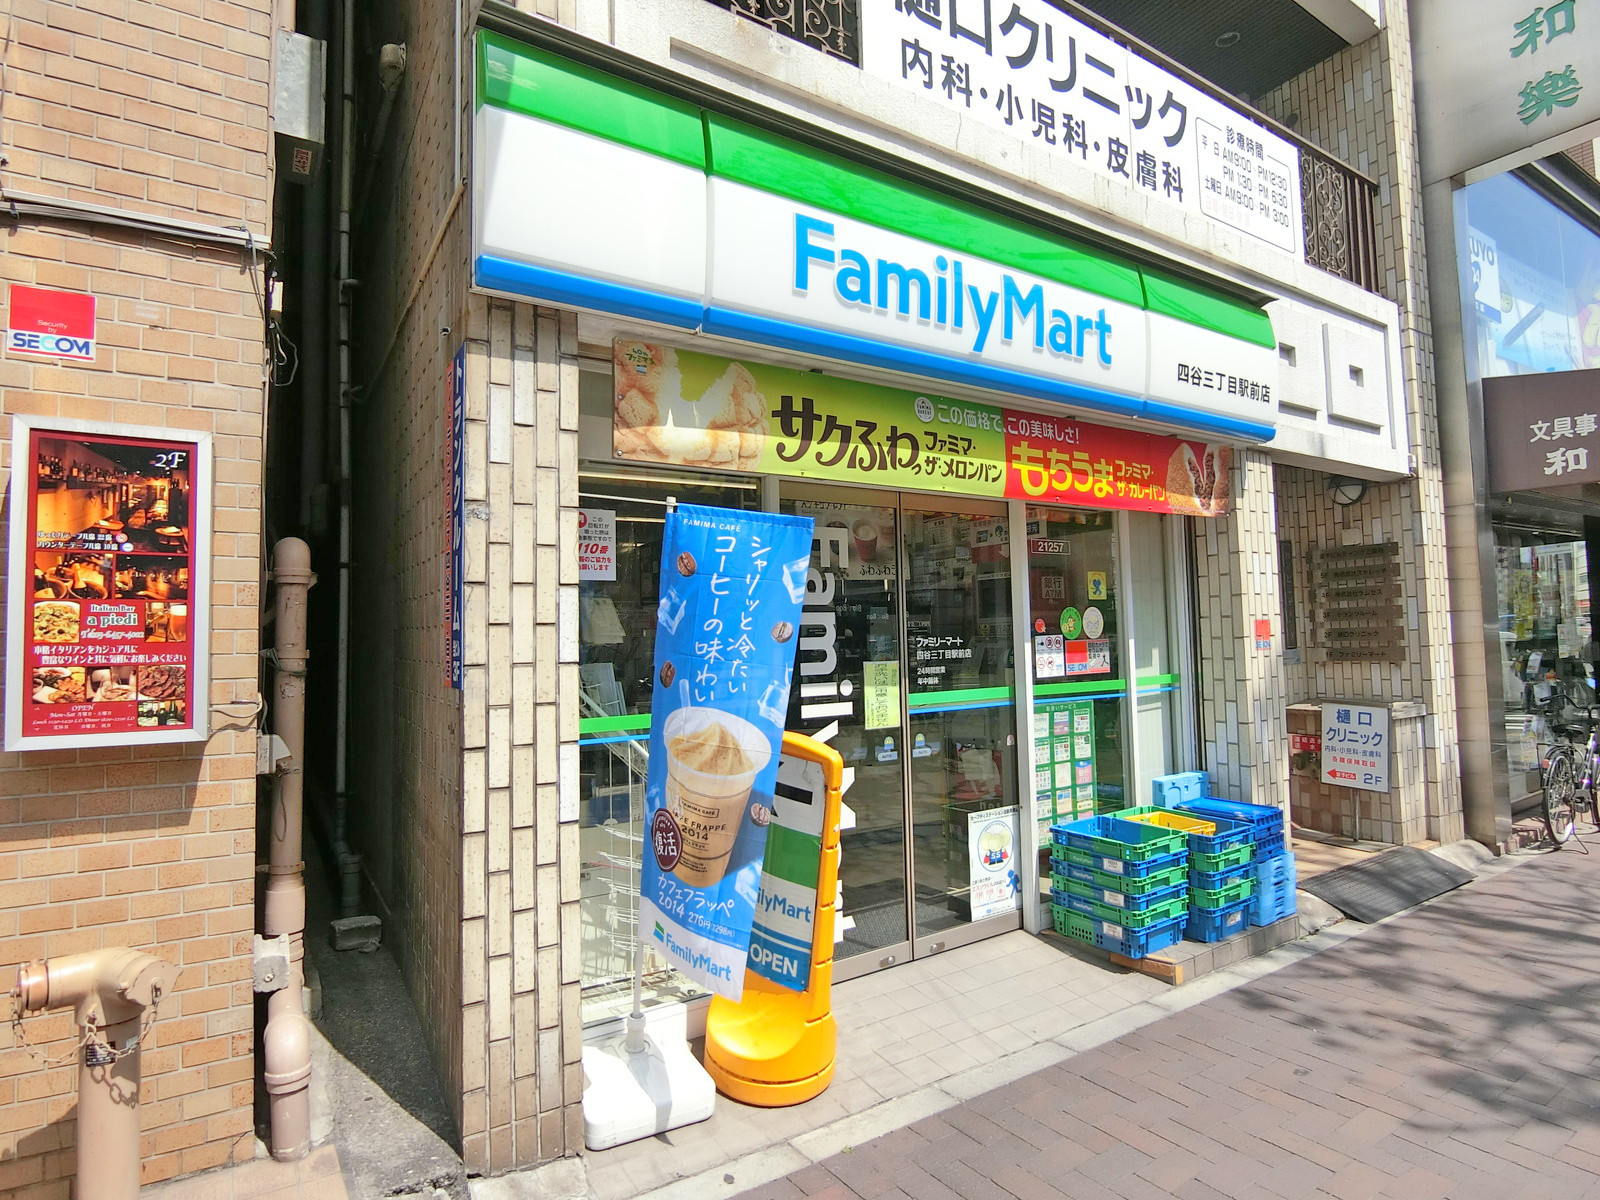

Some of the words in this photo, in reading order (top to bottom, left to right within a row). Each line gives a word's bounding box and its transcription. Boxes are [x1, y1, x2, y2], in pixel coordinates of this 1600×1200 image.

[901, 37, 1184, 203] 内科・小児科・皮膚科
[1226, 125, 1264, 161] 診療時間
[792, 211, 1112, 368] FamilyMart
[37, 319, 68, 330] Security
[47, 327, 58, 335] by
[13, 332, 90, 356] SECOM
[1177, 362, 1271, 403] 四谷三丁目駅前店
[1529, 413, 1598, 443] 文具事
[155, 451, 187, 468] 2F
[925, 456, 1003, 483] ザ・メロンパン
[1011, 440, 1114, 498] もちうま
[1543, 447, 1588, 476] 和
[683, 518, 716, 529] FAMIMA
[1037, 541, 1065, 553] 21257
[86, 615, 98, 626] a
[100, 612, 138, 628] piedi
[91, 604, 118, 613] Italian
[119, 604, 136, 613] Bar
[694, 535, 737, 702] コーヒーの味わい
[726, 535, 772, 693] シャリッと冷たい
[916, 636, 964, 648] ファミリーマート
[916, 648, 972, 660] 四谷三丁目駅前店
[1335, 708, 1372, 727] 樋口
[1326, 726, 1383, 747] クリニック
[1332, 755, 1376, 768] 各種保険取扱
[1363, 772, 1383, 785] 2F
[655, 830, 678, 856] 復活
[681, 825, 709, 841] 2014
[658, 873, 735, 918] カフェフラッペ
[658, 892, 685, 918] 2014
[688, 911, 711, 930] 276円
[666, 932, 732, 981] FamilyMart
[750, 943, 798, 978] OPEN
